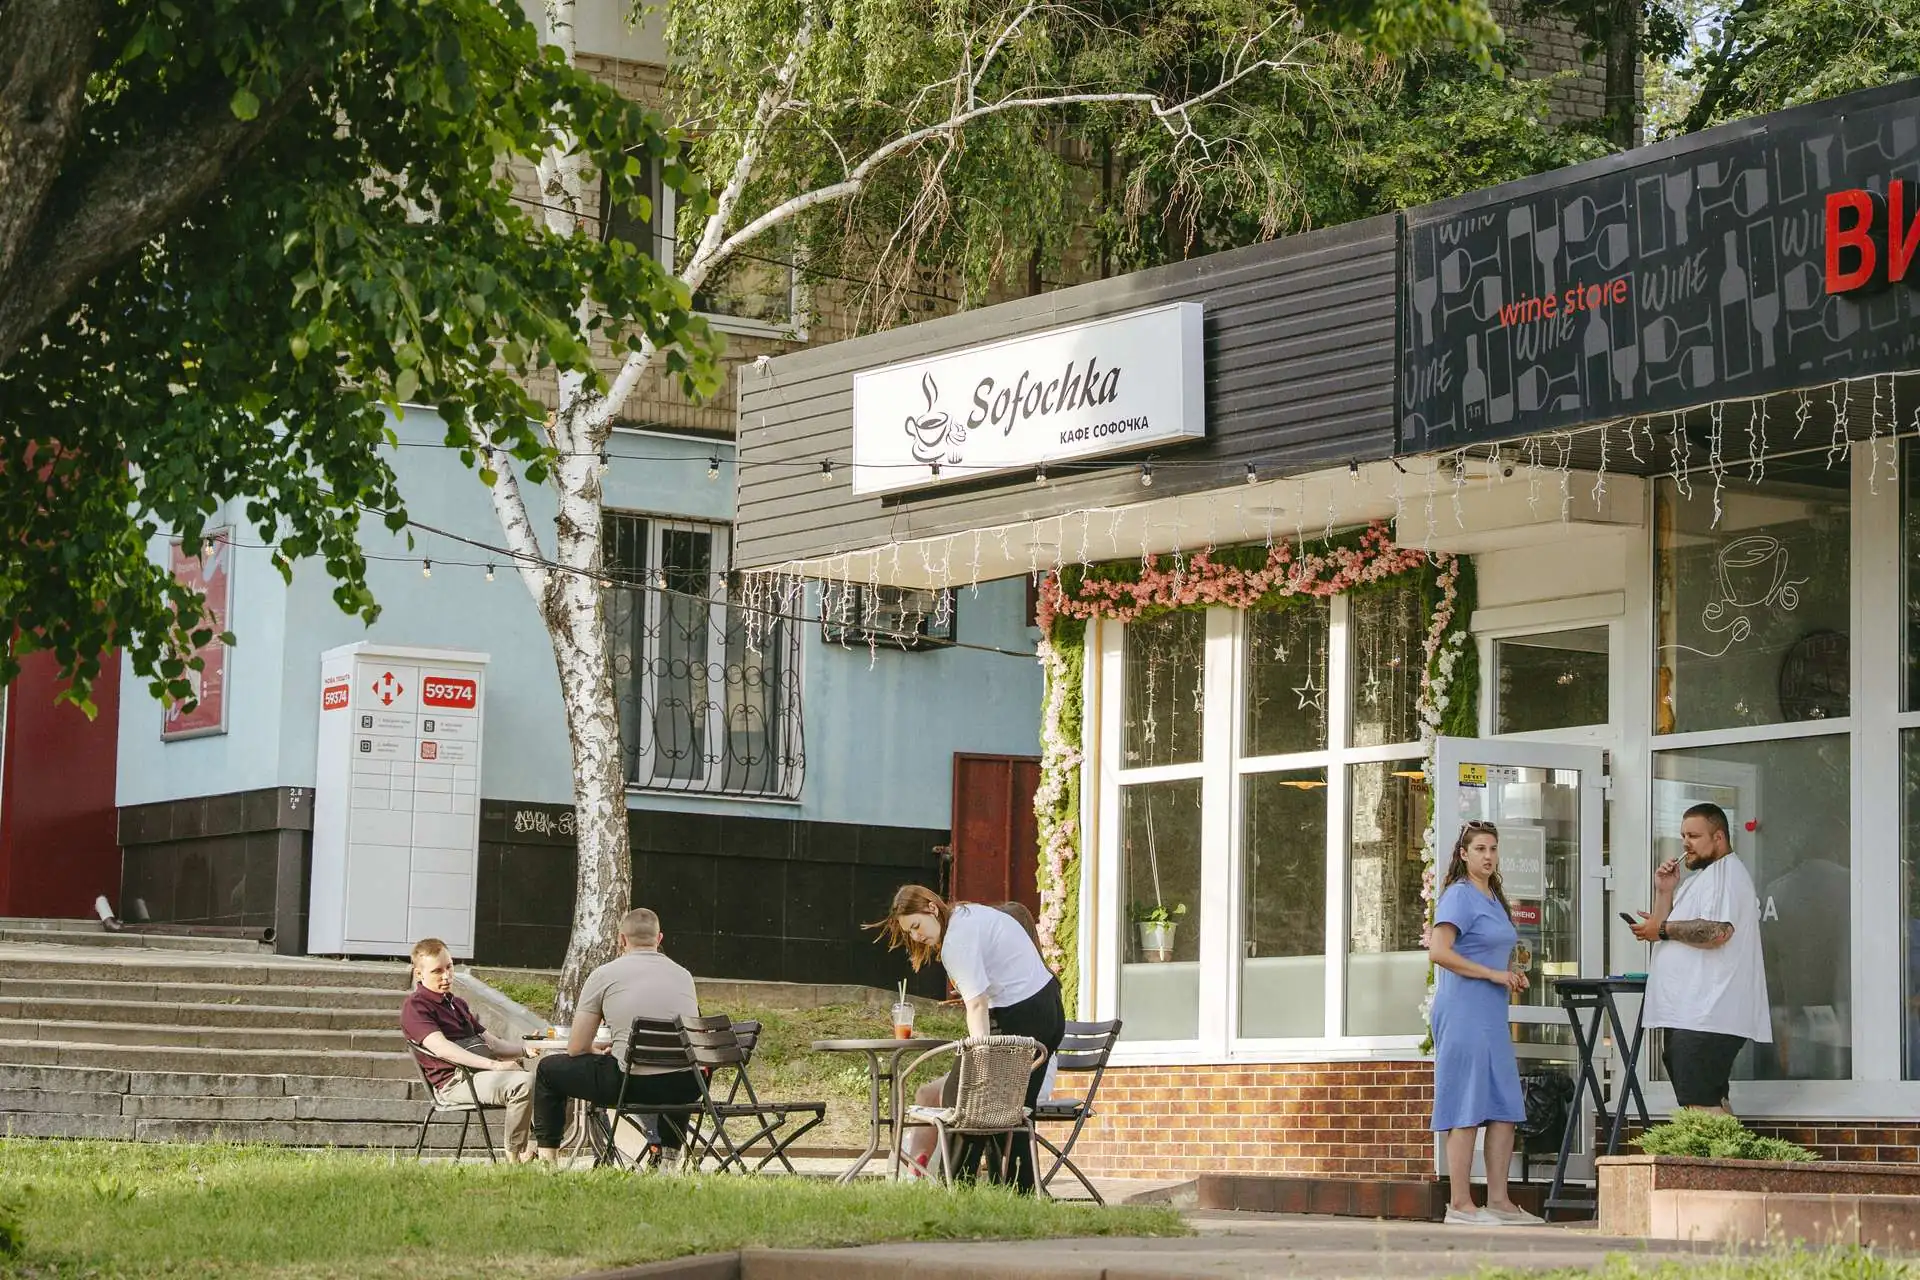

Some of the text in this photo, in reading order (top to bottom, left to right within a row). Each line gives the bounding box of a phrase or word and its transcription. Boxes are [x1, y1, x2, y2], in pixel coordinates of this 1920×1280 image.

[1498, 278, 1628, 328] wine store
[966, 355, 1122, 437] Sofochka
[1060, 415, 1149, 444] КАФЕ СОФОЧКА
[326, 690, 348, 704] 59374
[425, 683, 473, 700] 59374
